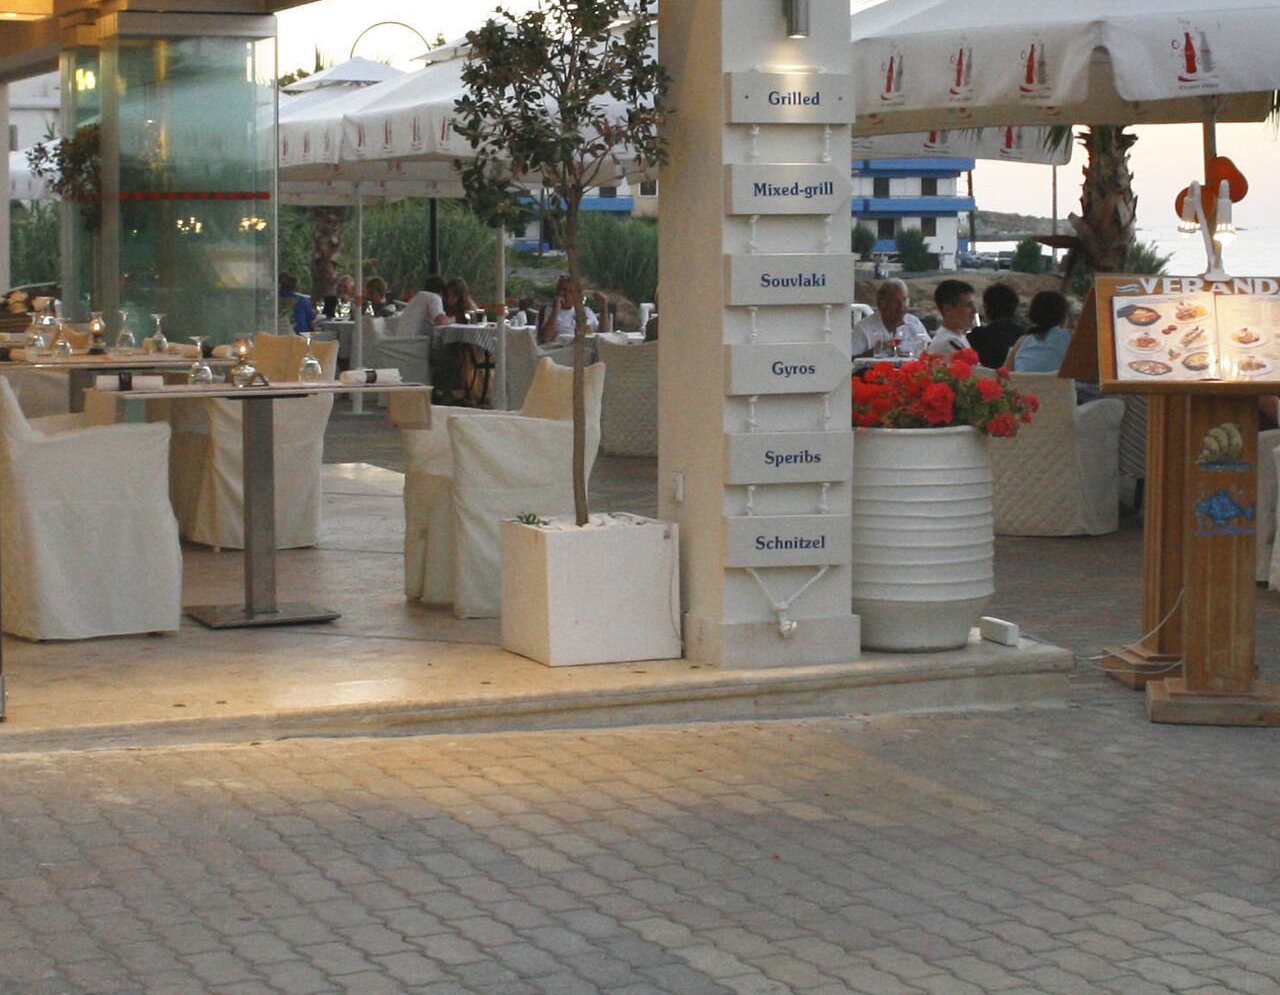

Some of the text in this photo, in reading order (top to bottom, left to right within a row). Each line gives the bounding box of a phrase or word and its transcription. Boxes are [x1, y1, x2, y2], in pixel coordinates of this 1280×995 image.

[768, 91, 821, 106] Grilled
[753, 182, 834, 199] Mixed-grill
[760, 273, 827, 288] Souvlaki
[771, 361, 816, 378] Gyros
[764, 450, 822, 467] Speribs
[755, 535, 826, 551] Schnitzel
